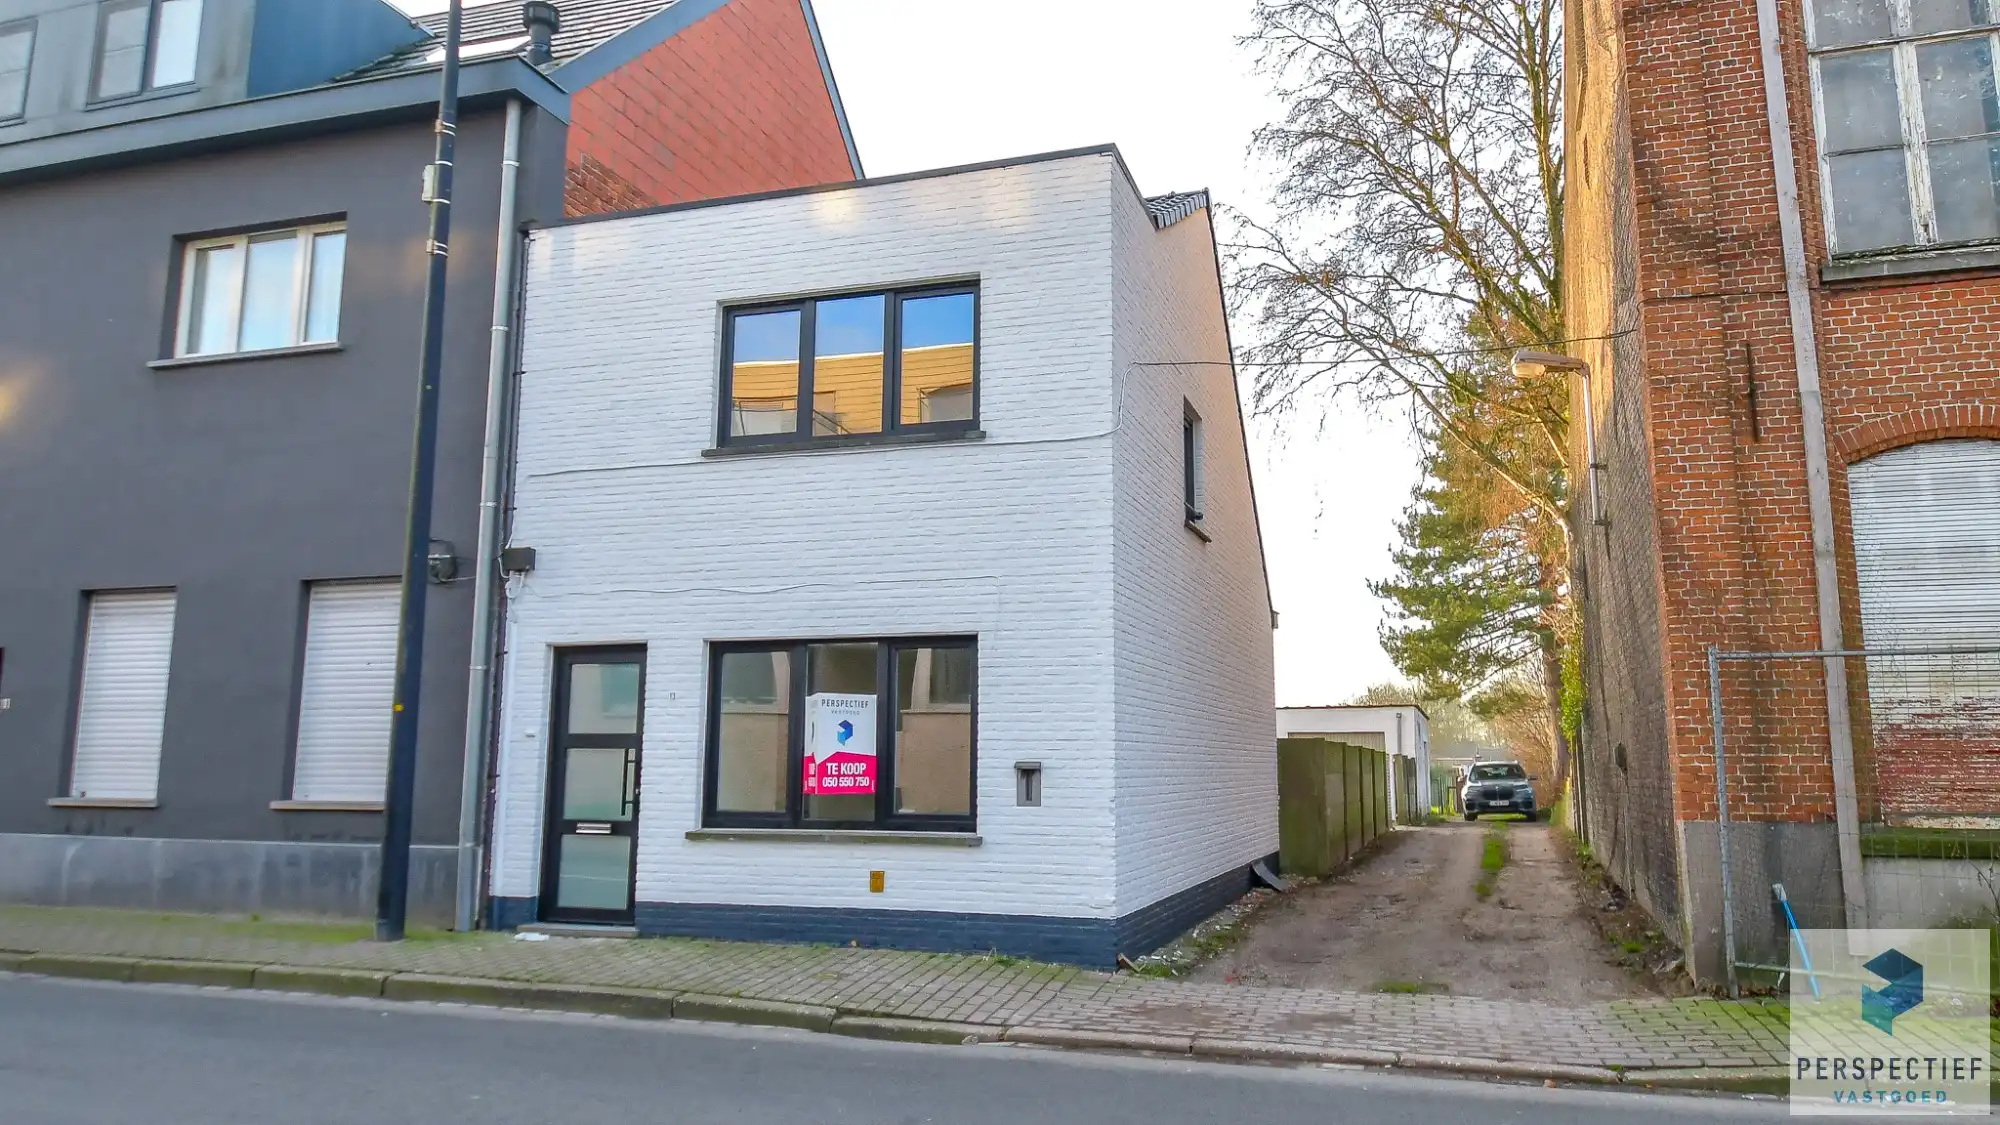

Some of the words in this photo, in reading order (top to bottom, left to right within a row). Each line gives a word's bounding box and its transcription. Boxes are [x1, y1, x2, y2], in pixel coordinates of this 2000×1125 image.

[821, 699, 869, 709] PERSPECTIEF
[826, 762, 839, 775] TE
[840, 762, 867, 775] KOOP
[822, 777, 838, 787] 050
[839, 777, 854, 787] 550
[855, 777, 870, 787] 750
